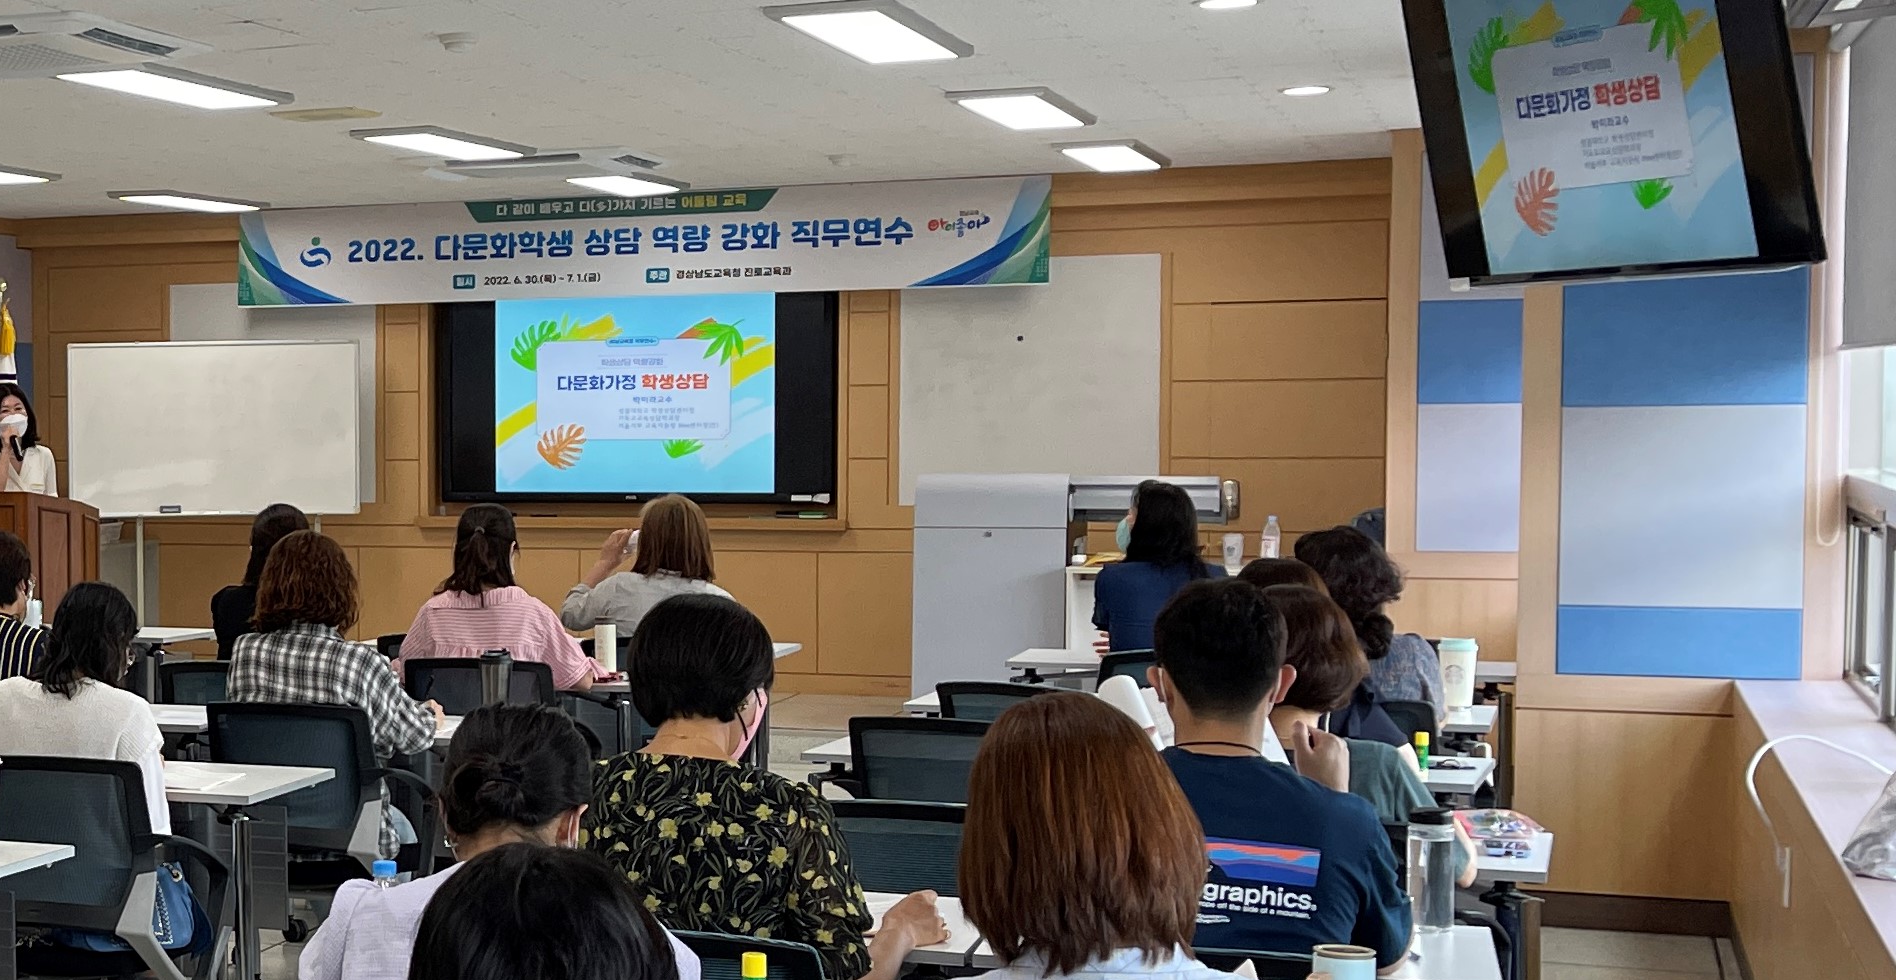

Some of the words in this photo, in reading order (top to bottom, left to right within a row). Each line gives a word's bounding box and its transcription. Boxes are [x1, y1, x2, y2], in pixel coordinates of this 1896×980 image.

[1515, 86, 1591, 119] 다문화가정
[1593, 73, 1661, 107] 학생상담
[496, 204, 508, 216] 다
[539, 201, 574, 214] 배우고
[722, 193, 747, 206] 교육
[347, 238, 424, 264] 2022.
[434, 230, 574, 262] 다문화학생
[584, 226, 643, 256] 상담
[651, 223, 710, 254] 역량
[720, 221, 781, 252] 강화
[791, 216, 914, 248] 직무연수
[484, 277, 511, 286] 2022.
[676, 267, 741, 279] 경상남도교육청
[557, 374, 636, 391] 다문화가정
[641, 373, 710, 391] 학생상담
